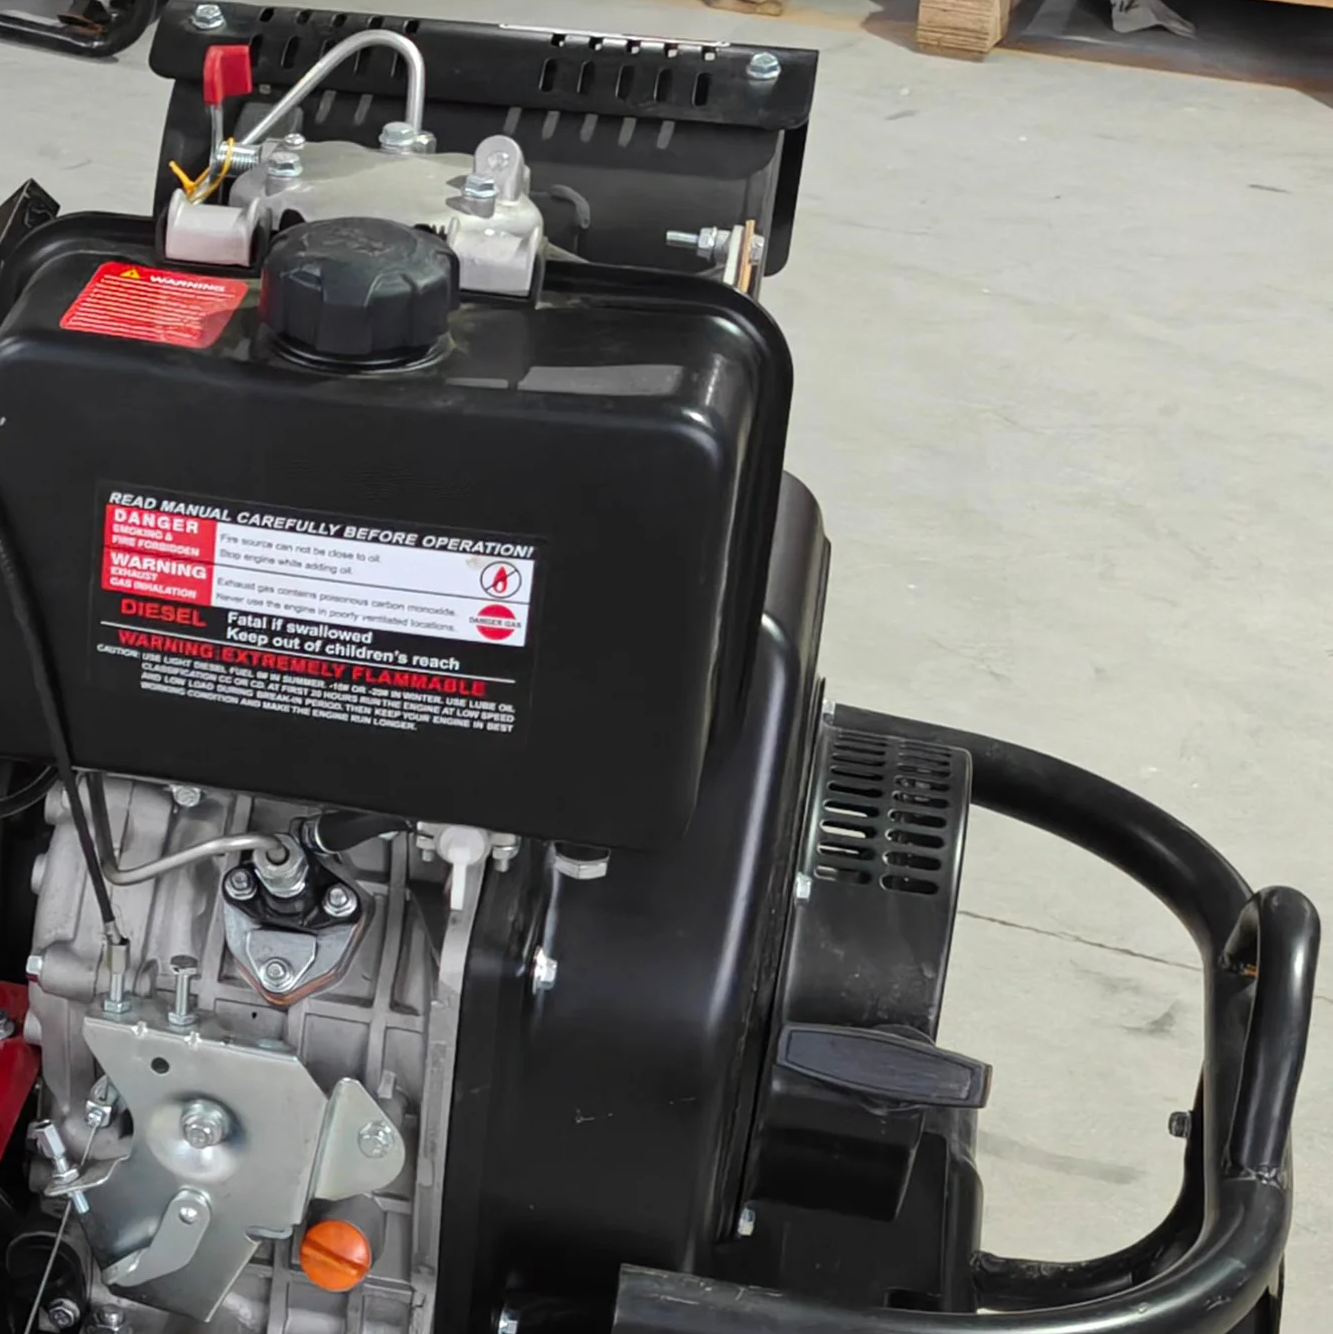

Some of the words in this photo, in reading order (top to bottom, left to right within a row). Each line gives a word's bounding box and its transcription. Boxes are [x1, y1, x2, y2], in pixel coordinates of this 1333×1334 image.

[149, 274, 226, 293] WARNING
[108, 491, 156, 510] READ
[160, 499, 231, 521] MANUAL
[237, 511, 340, 536] CAREFULLY
[343, 525, 418, 546] BEFORE
[422, 532, 533, 560] OPERATION!
[112, 523, 162, 539] SMOKING
[113, 508, 199, 533] DANGER
[111, 534, 135, 546] FIRE
[138, 539, 199, 556] FORBIDDEN
[276, 542, 293, 552] can
[295, 544, 311, 554] not
[313, 546, 325, 556] be
[328, 548, 354, 559] close
[356, 552, 365, 561] to
[110, 552, 207, 579] WARNING
[110, 566, 158, 581] EXHAUST
[109, 576, 131, 588] GAS
[120, 598, 207, 628] DIESEL
[227, 610, 267, 629] Fatal
[271, 617, 284, 631] if
[286, 619, 372, 644] swallowed
[226, 627, 268, 647] Keep
[272, 634, 300, 650] out
[304, 637, 321, 653] of
[325, 640, 408, 665] children's
[412, 652, 460, 671] reach
[221, 645, 346, 679] EXTREMELY
[351, 663, 487, 699] FLAMMABLE
